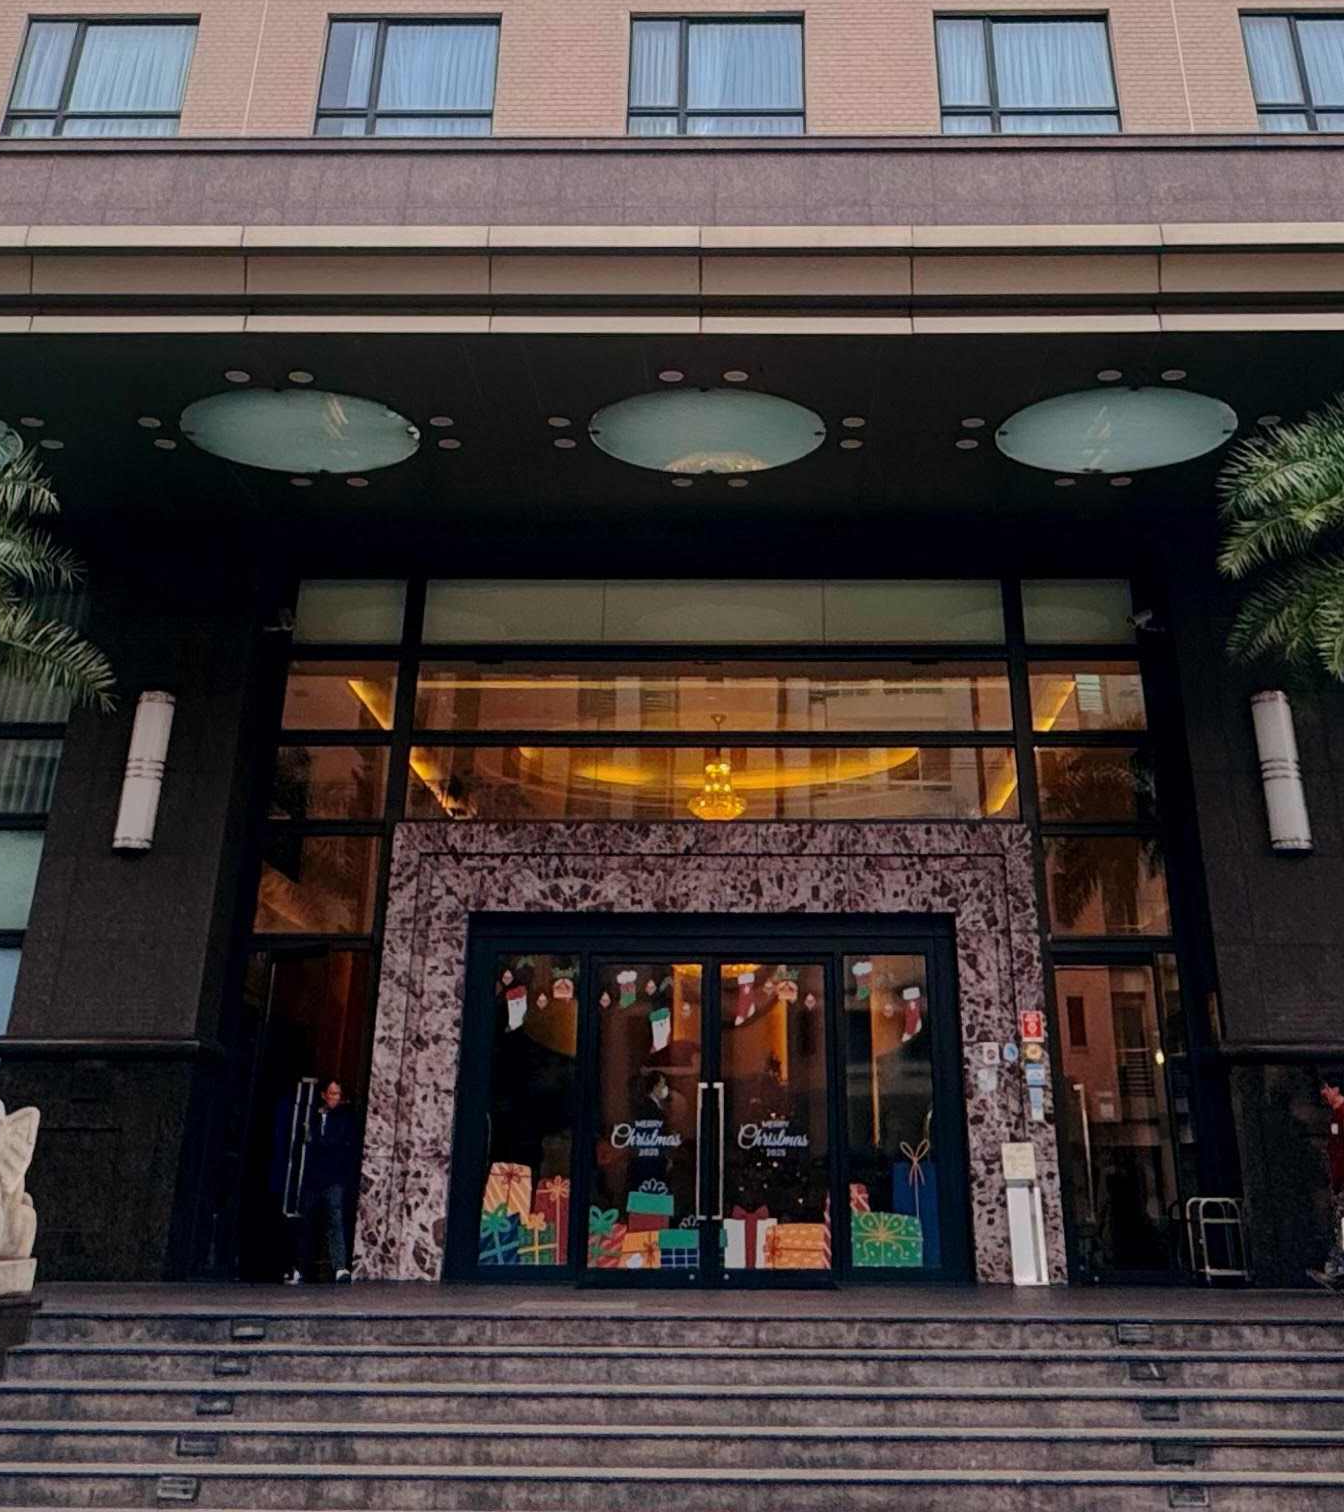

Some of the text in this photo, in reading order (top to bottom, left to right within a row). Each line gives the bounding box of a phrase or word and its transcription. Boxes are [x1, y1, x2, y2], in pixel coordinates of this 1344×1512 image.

[635, 1120, 663, 1129] MERRY
[761, 1120, 790, 1129] MERRY
[610, 1123, 682, 1149] Christmas
[737, 1123, 809, 1150] Christmas
